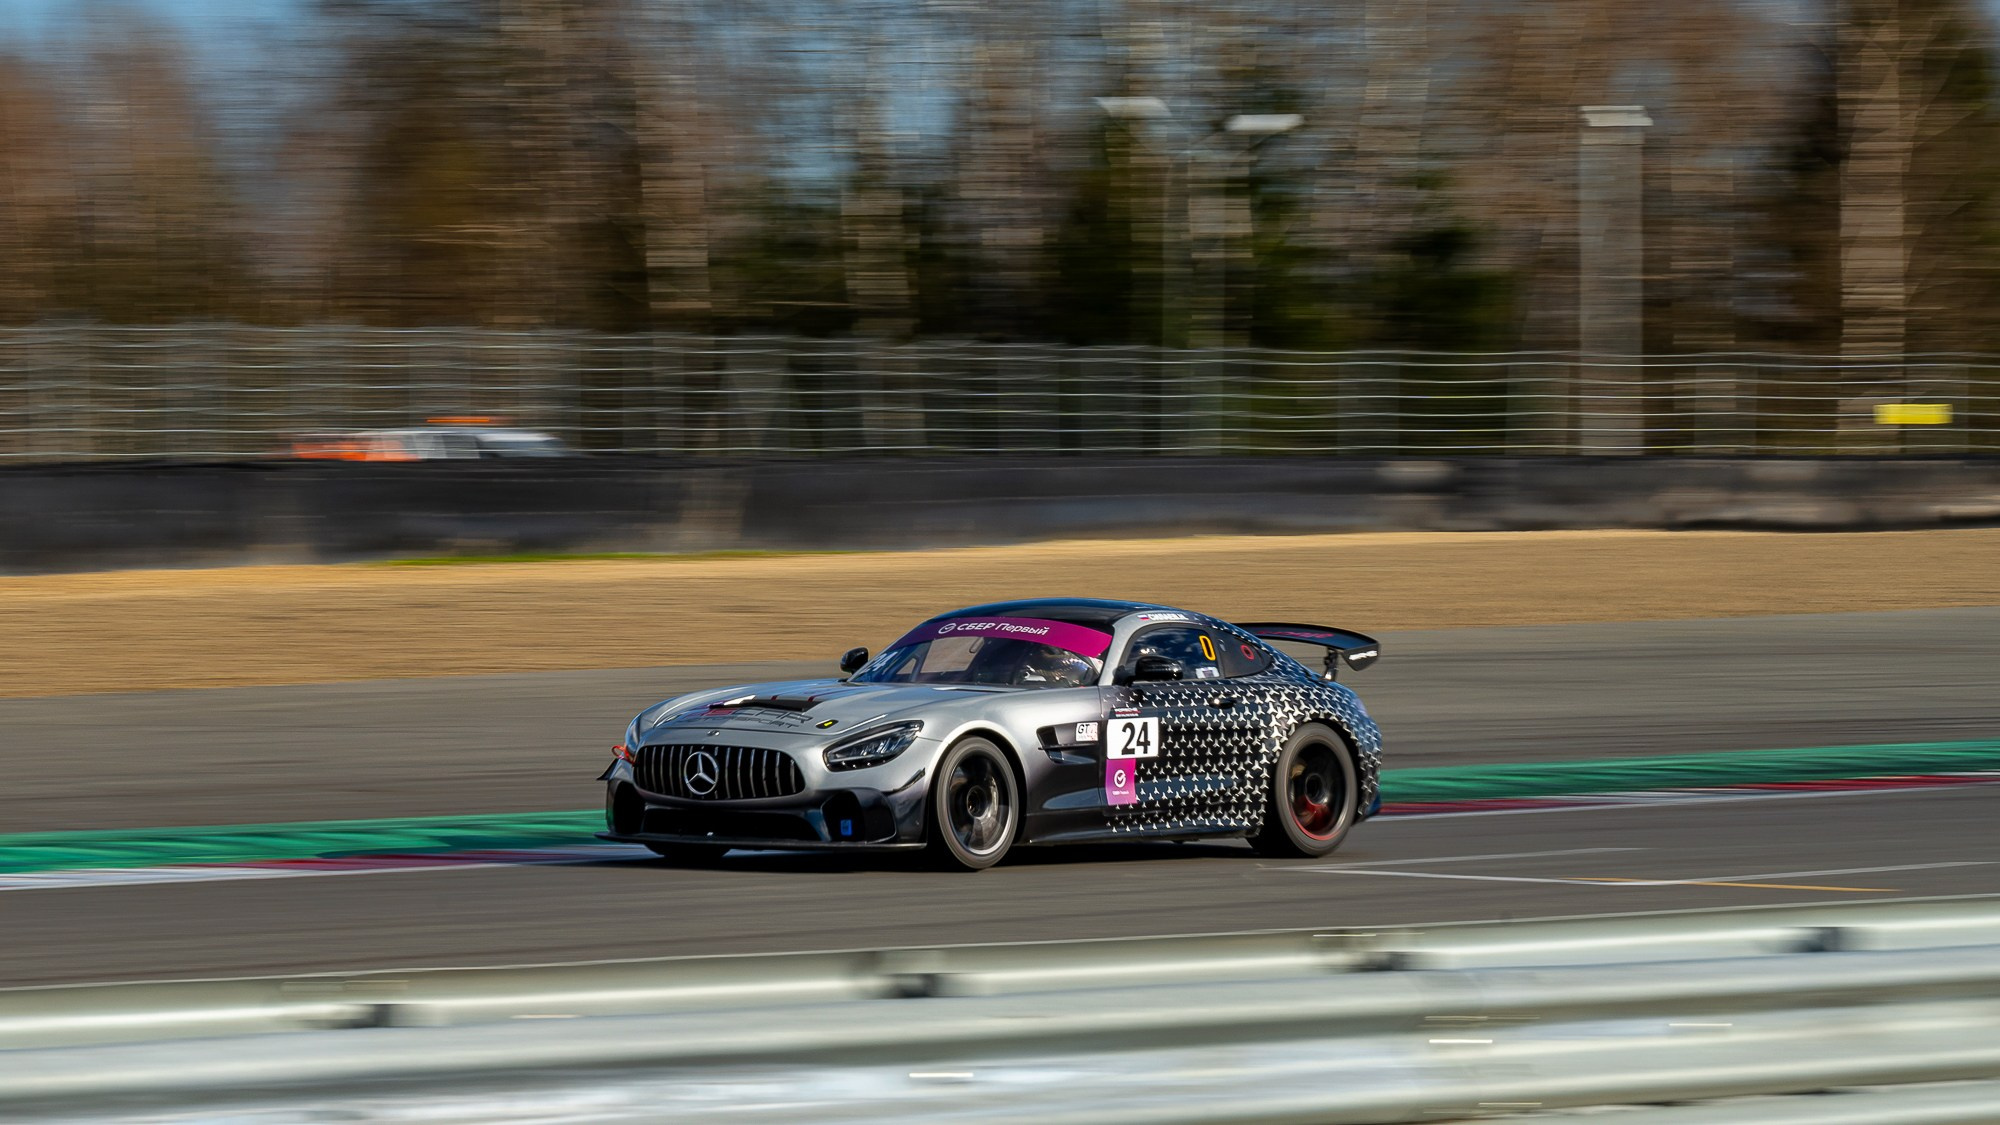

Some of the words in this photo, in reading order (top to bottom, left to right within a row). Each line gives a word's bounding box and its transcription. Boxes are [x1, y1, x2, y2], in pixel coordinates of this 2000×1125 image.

[957, 622, 996, 631] СБЕР
[995, 622, 1050, 636] Первый
[1121, 721, 1151, 756] 24
